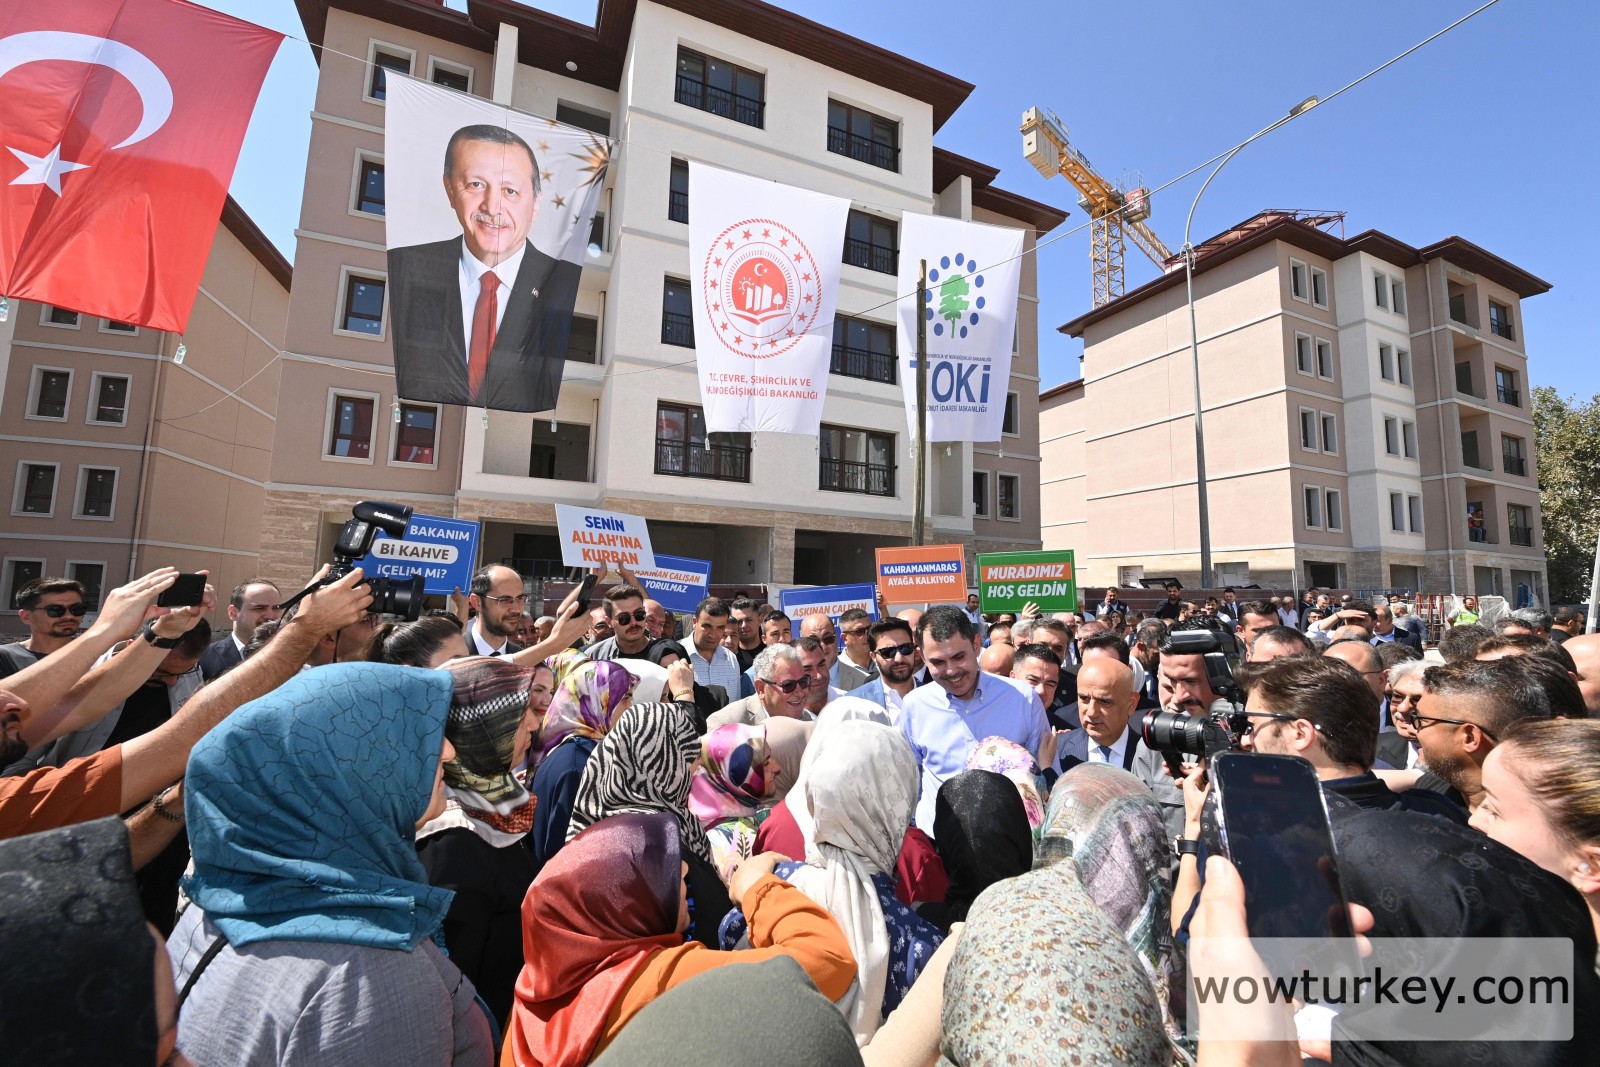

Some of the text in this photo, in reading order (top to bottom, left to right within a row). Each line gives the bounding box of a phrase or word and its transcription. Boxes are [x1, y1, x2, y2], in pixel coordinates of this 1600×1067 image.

[720, 373, 748, 384] ÇEVRE,
[751, 374, 797, 386] ŞEHİRCİLİK
[800, 378, 811, 387] VE
[770, 389, 818, 400] BAKANLIĞI
[584, 515, 625, 532] SENİN
[410, 525, 470, 541] BAKANIM
[572, 530, 643, 550] ALLAH'INA
[398, 545, 450, 560] KAHVE
[581, 548, 639, 565] KURBAN
[884, 563, 957, 574] KAHRAMANMARAŞ
[987, 564, 1065, 580] MURADIMIZ
[669, 573, 701, 583] ÇALIŞAN
[888, 575, 956, 586] AYAĞA KALKIYOR
[645, 580, 688, 593] YORULMAZ
[987, 581, 1067, 600] HOŞ GELDİN
[793, 605, 830, 618] AŞKINAN
